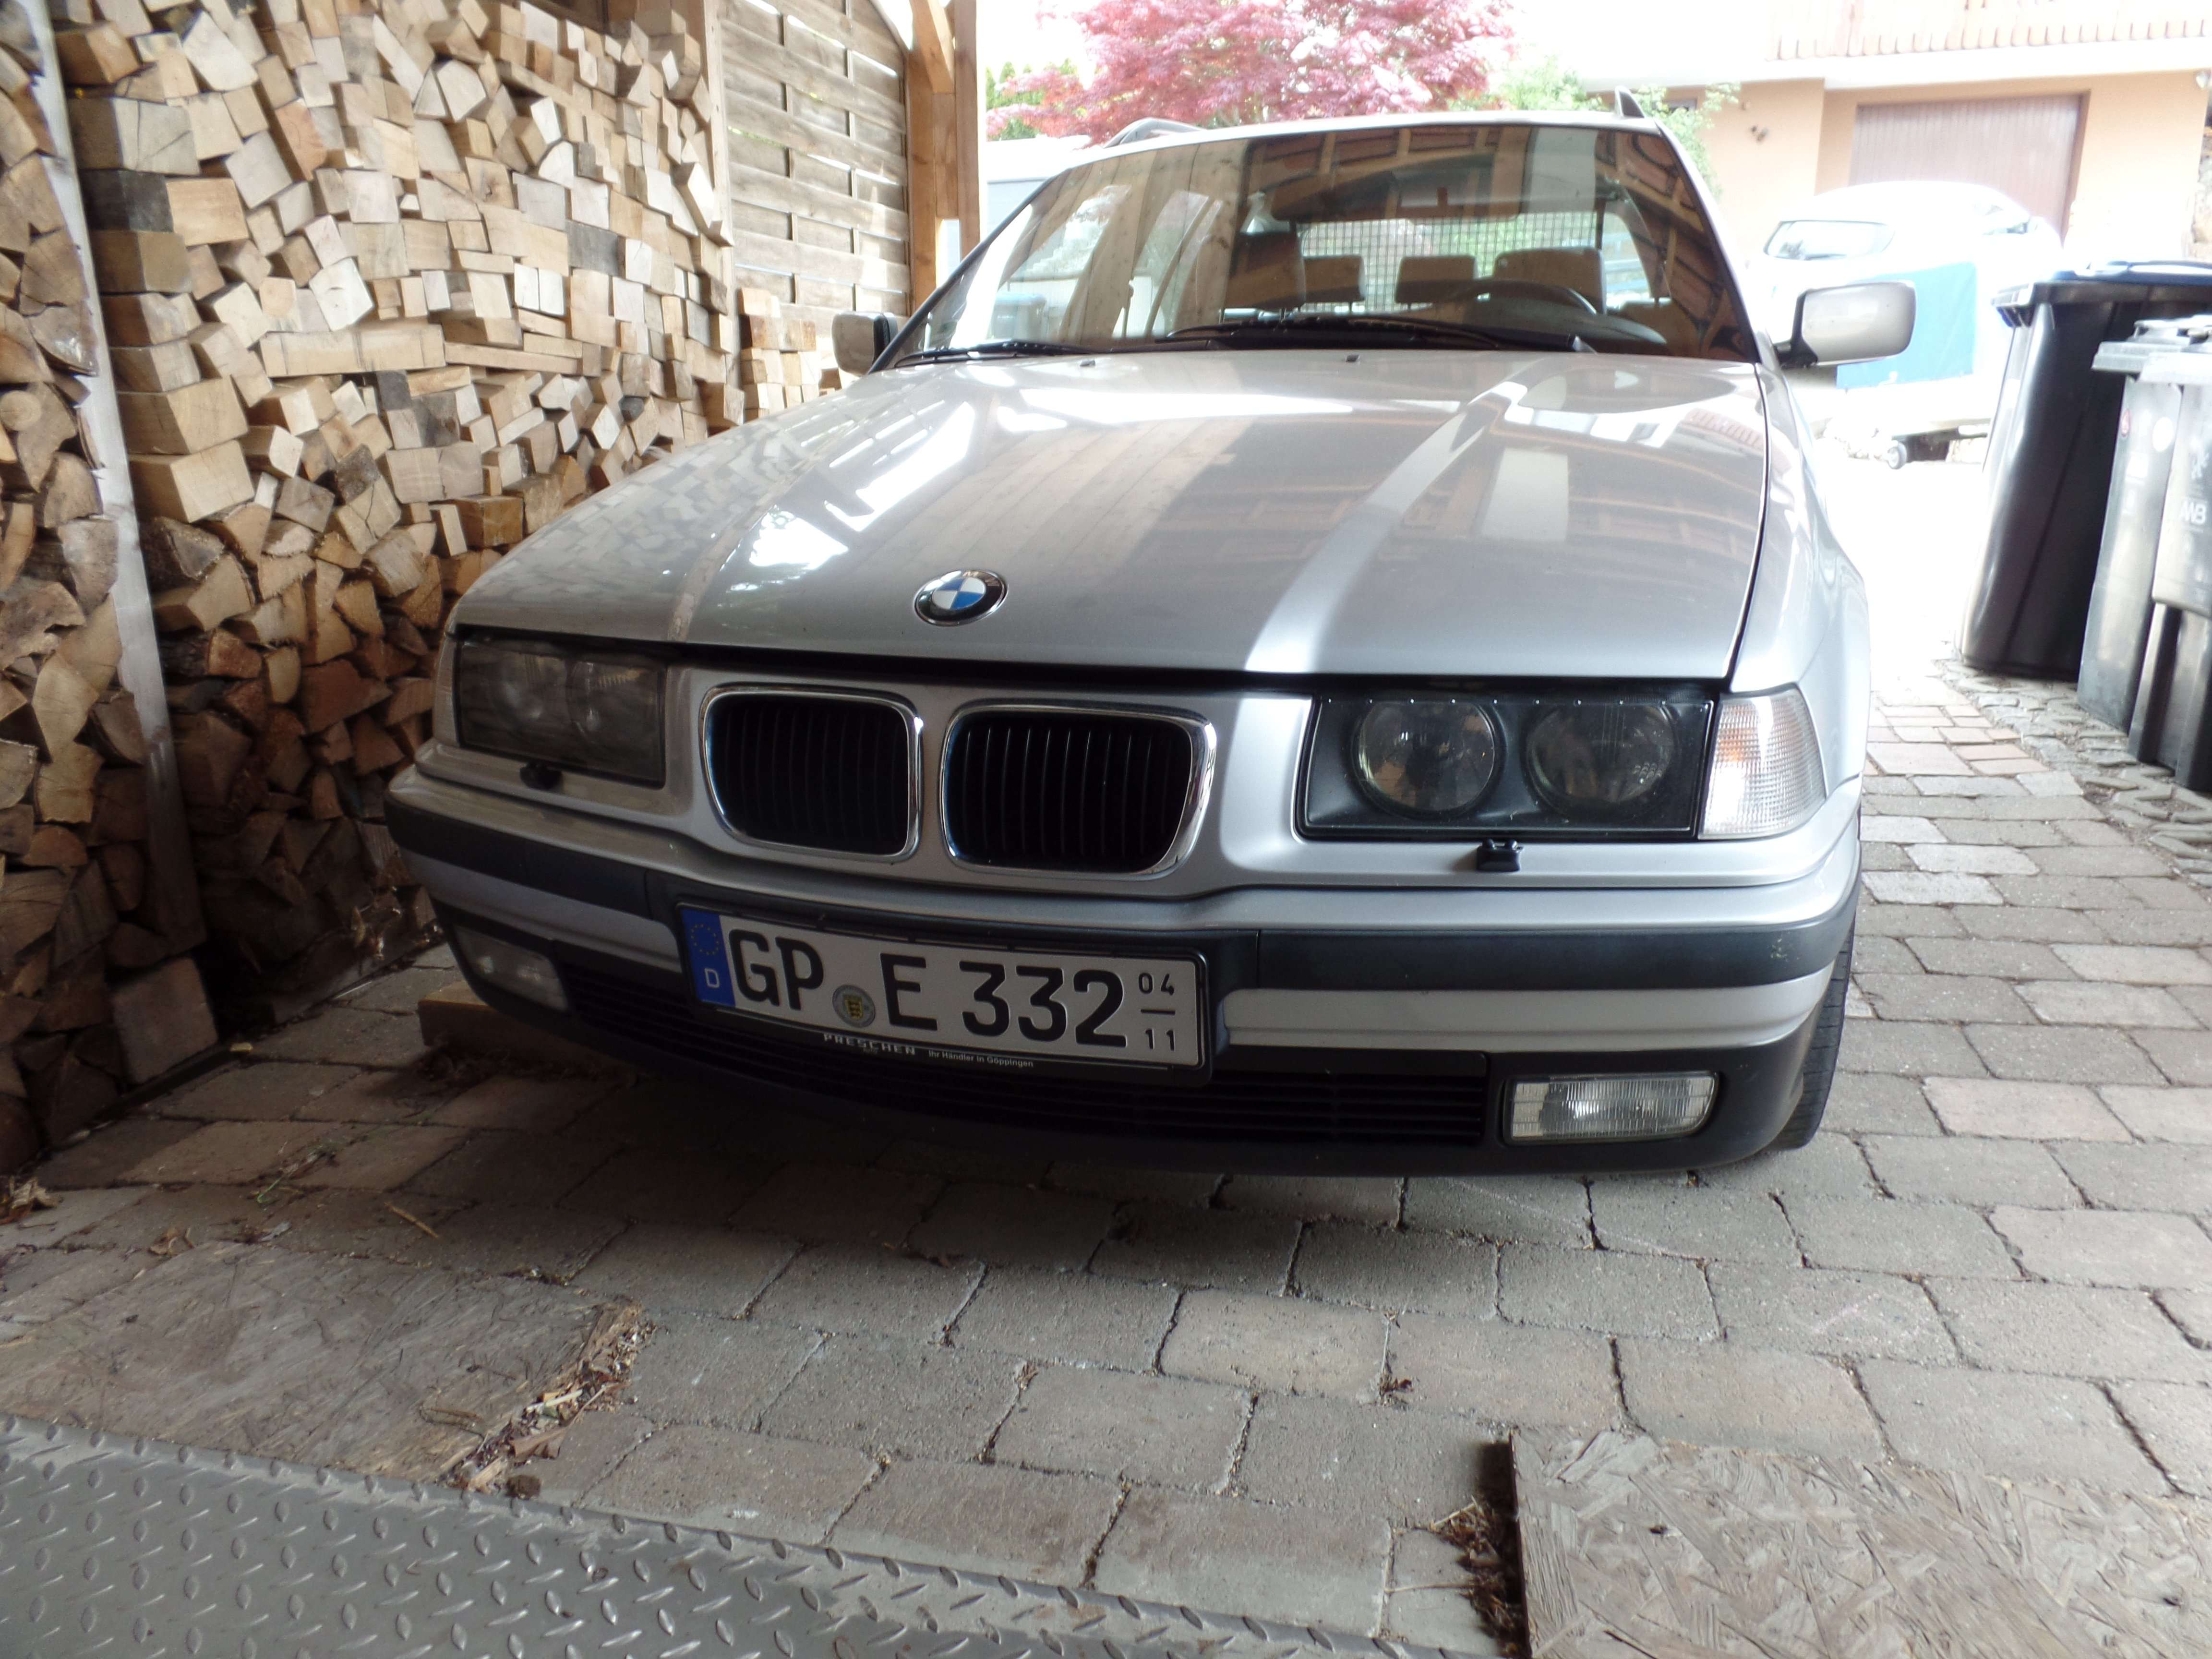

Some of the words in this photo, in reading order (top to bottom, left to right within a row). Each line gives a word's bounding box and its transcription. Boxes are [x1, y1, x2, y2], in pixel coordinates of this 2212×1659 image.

[704, 968, 720, 988] D
[728, 929, 824, 1010] GP
[880, 953, 938, 1031] E
[960, 961, 1126, 1047] 332
[1138, 973, 1175, 995] 04
[1145, 1029, 1175, 1050] 11
[823, 1034, 915, 1055] PRESCHEN
[929, 1049, 940, 1058] Ihr
[942, 1051, 974, 1061] Händler
[987, 1056, 1034, 1068] Göppingen
